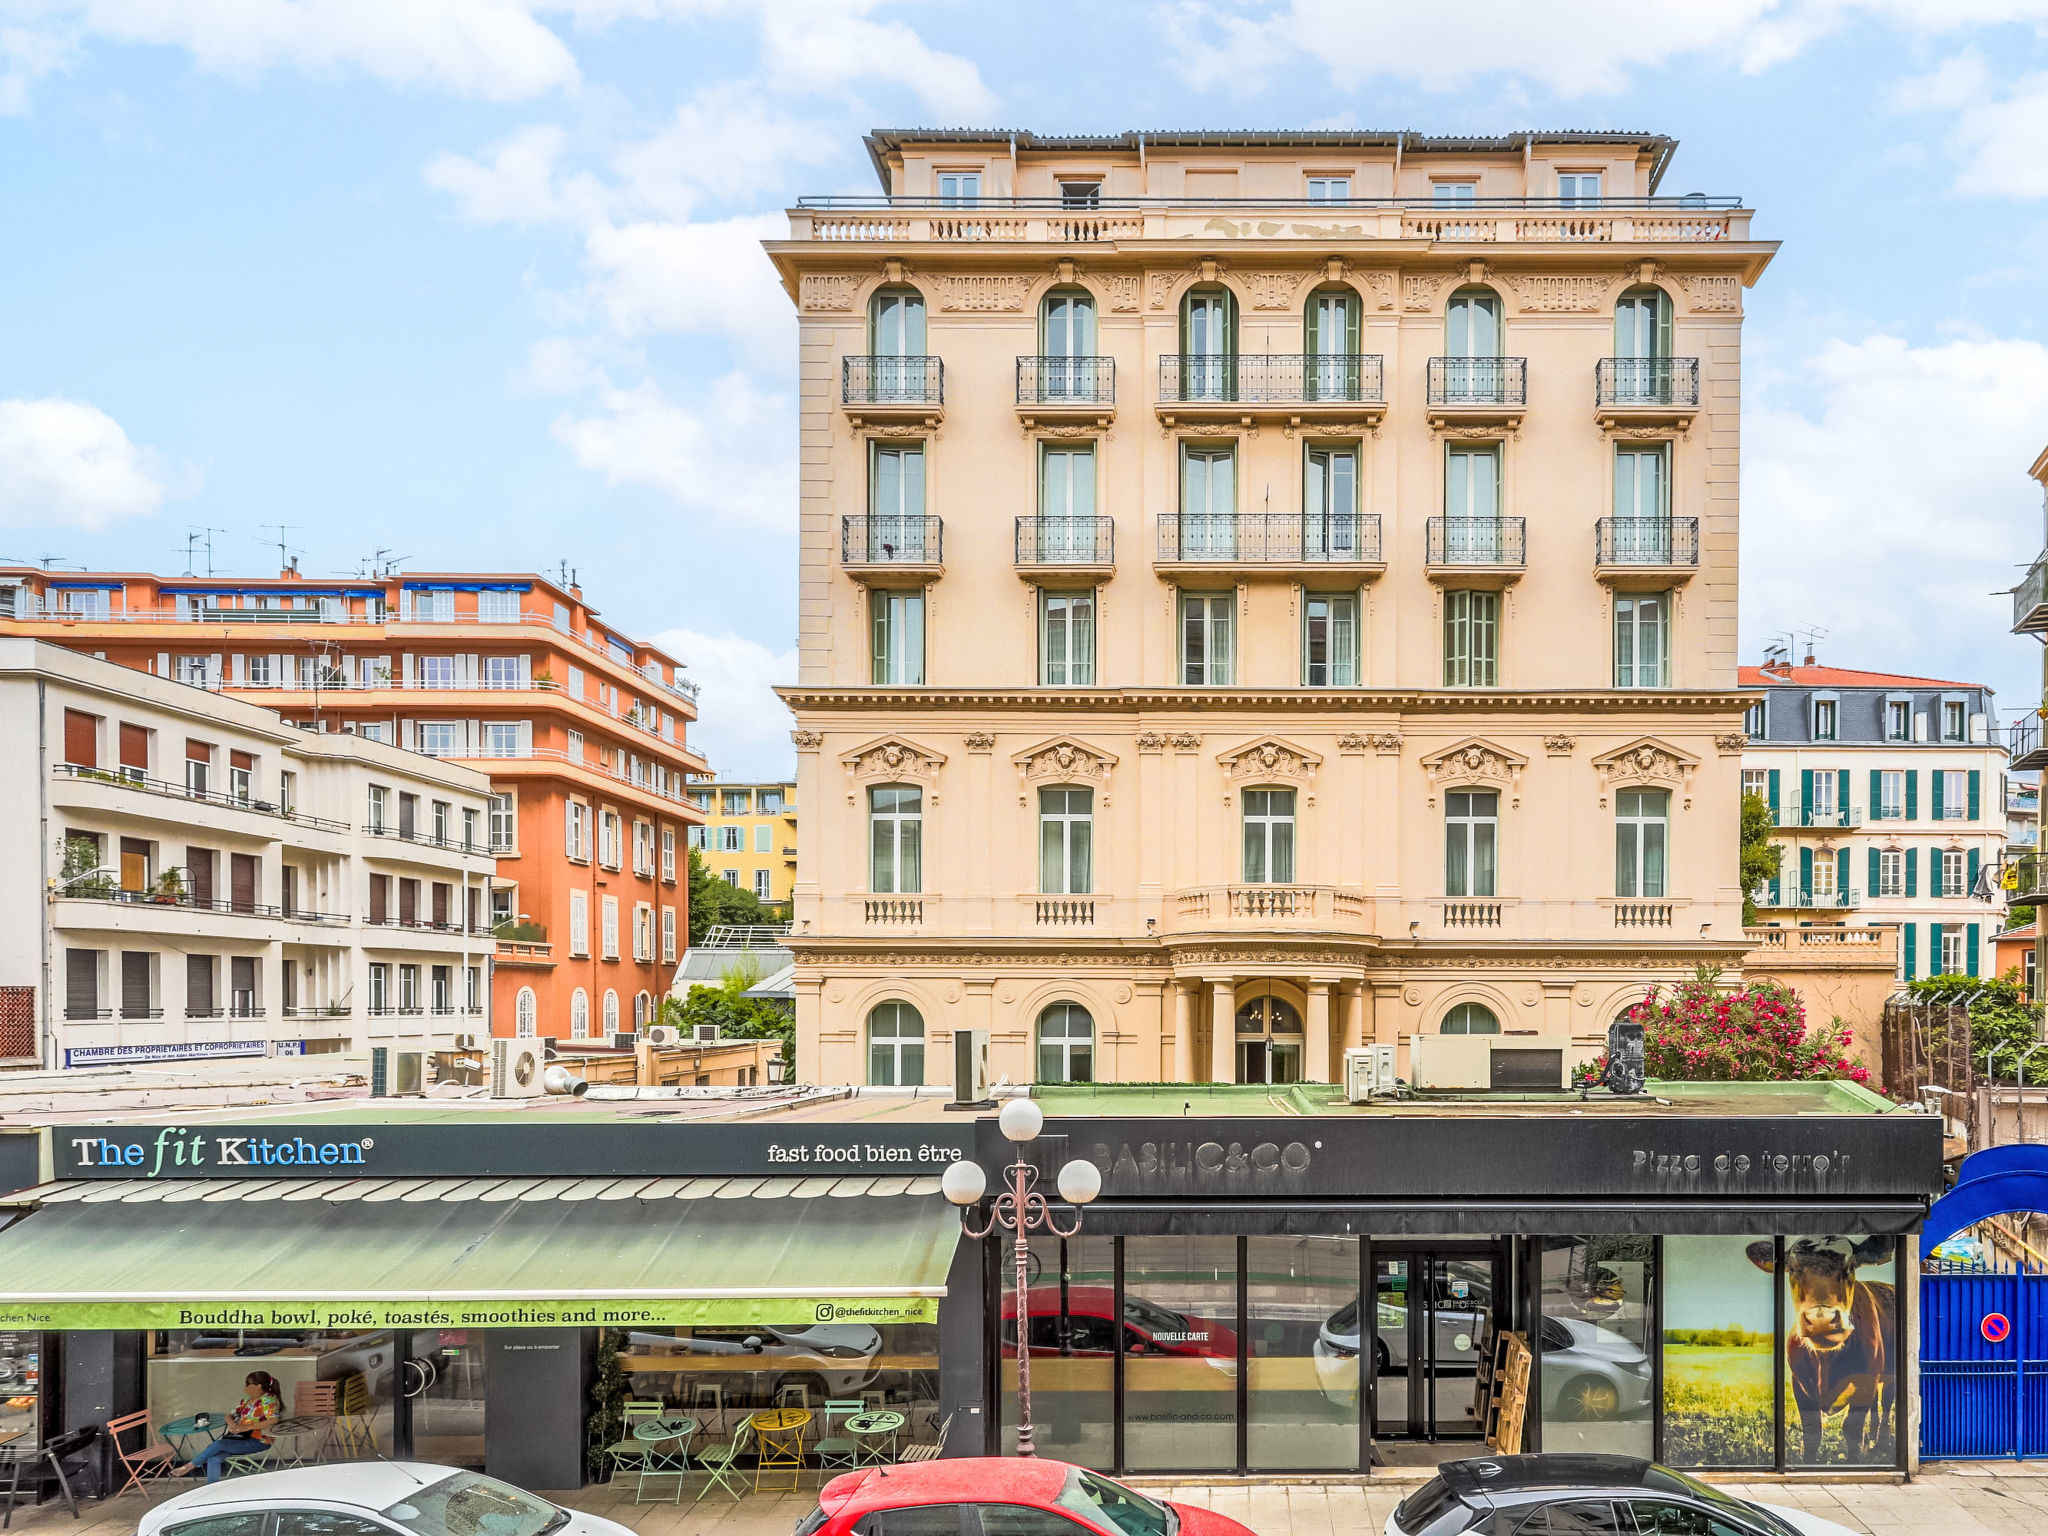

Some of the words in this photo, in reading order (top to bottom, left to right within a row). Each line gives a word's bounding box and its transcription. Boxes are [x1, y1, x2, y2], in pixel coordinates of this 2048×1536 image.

[73, 1047, 115, 1057] CHAMBRE
[117, 1046, 132, 1055] DES
[135, 1044, 193, 1054] PROPRIETAIRES
[195, 1043, 203, 1052] ET
[204, 1041, 265, 1051] COPROPRIETAIRES
[71, 1137, 144, 1166] The
[147, 1127, 206, 1177] fit
[767, 1145, 809, 1162] fast
[814, 1145, 860, 1162] food
[865, 1144, 912, 1162] bien
[917, 1144, 962, 1162] être
[1633, 1150, 1701, 1171] Pizza
[1714, 1150, 1751, 1171] de
[1762, 1150, 1851, 1171] terroir
[27, 1312, 51, 1322] Nice
[179, 1310, 265, 1324] Bouddha
[271, 1310, 321, 1325] bowl,
[327, 1310, 377, 1327] poké,
[385, 1310, 455, 1326] toastés,
[461, 1309, 555, 1324] smoothies
[562, 1308, 597, 1323] and
[603, 1310, 666, 1322] more...
[835, 1307, 923, 1318] @thefitkitchen_nice
[1152, 1332, 1186, 1341] NOUVELLE
[1187, 1332, 1209, 1341] CARTE
[1128, 1412, 1235, 1421] www.basilic-and-co.com
